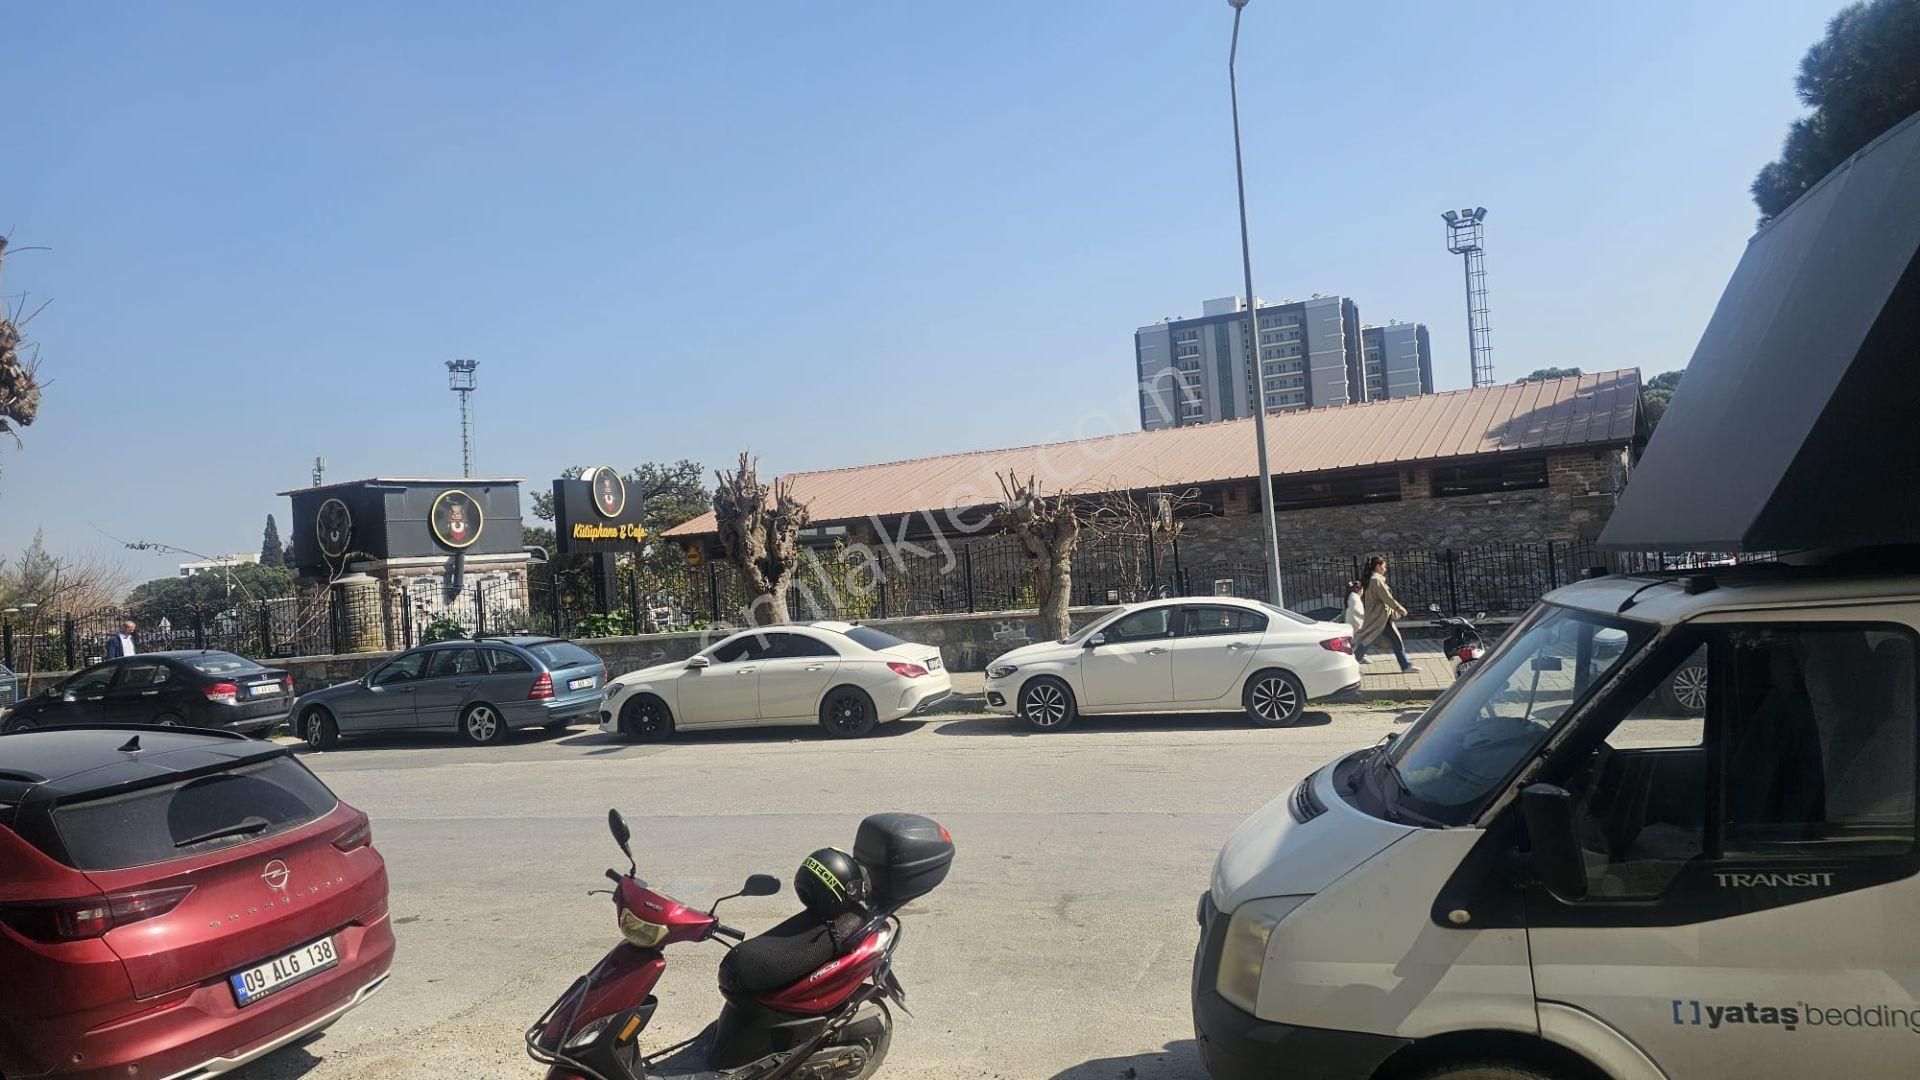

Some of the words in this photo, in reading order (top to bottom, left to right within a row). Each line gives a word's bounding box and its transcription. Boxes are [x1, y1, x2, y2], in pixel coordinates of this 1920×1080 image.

[573, 523, 618, 542] Kütüphane
[620, 524, 628, 539] &
[1713, 872, 1835, 888] TRANSIT
[244, 968, 266, 993] 09
[272, 954, 300, 982] ALG
[306, 940, 333, 966] 138
[1704, 1002, 1799, 1031] yataş
